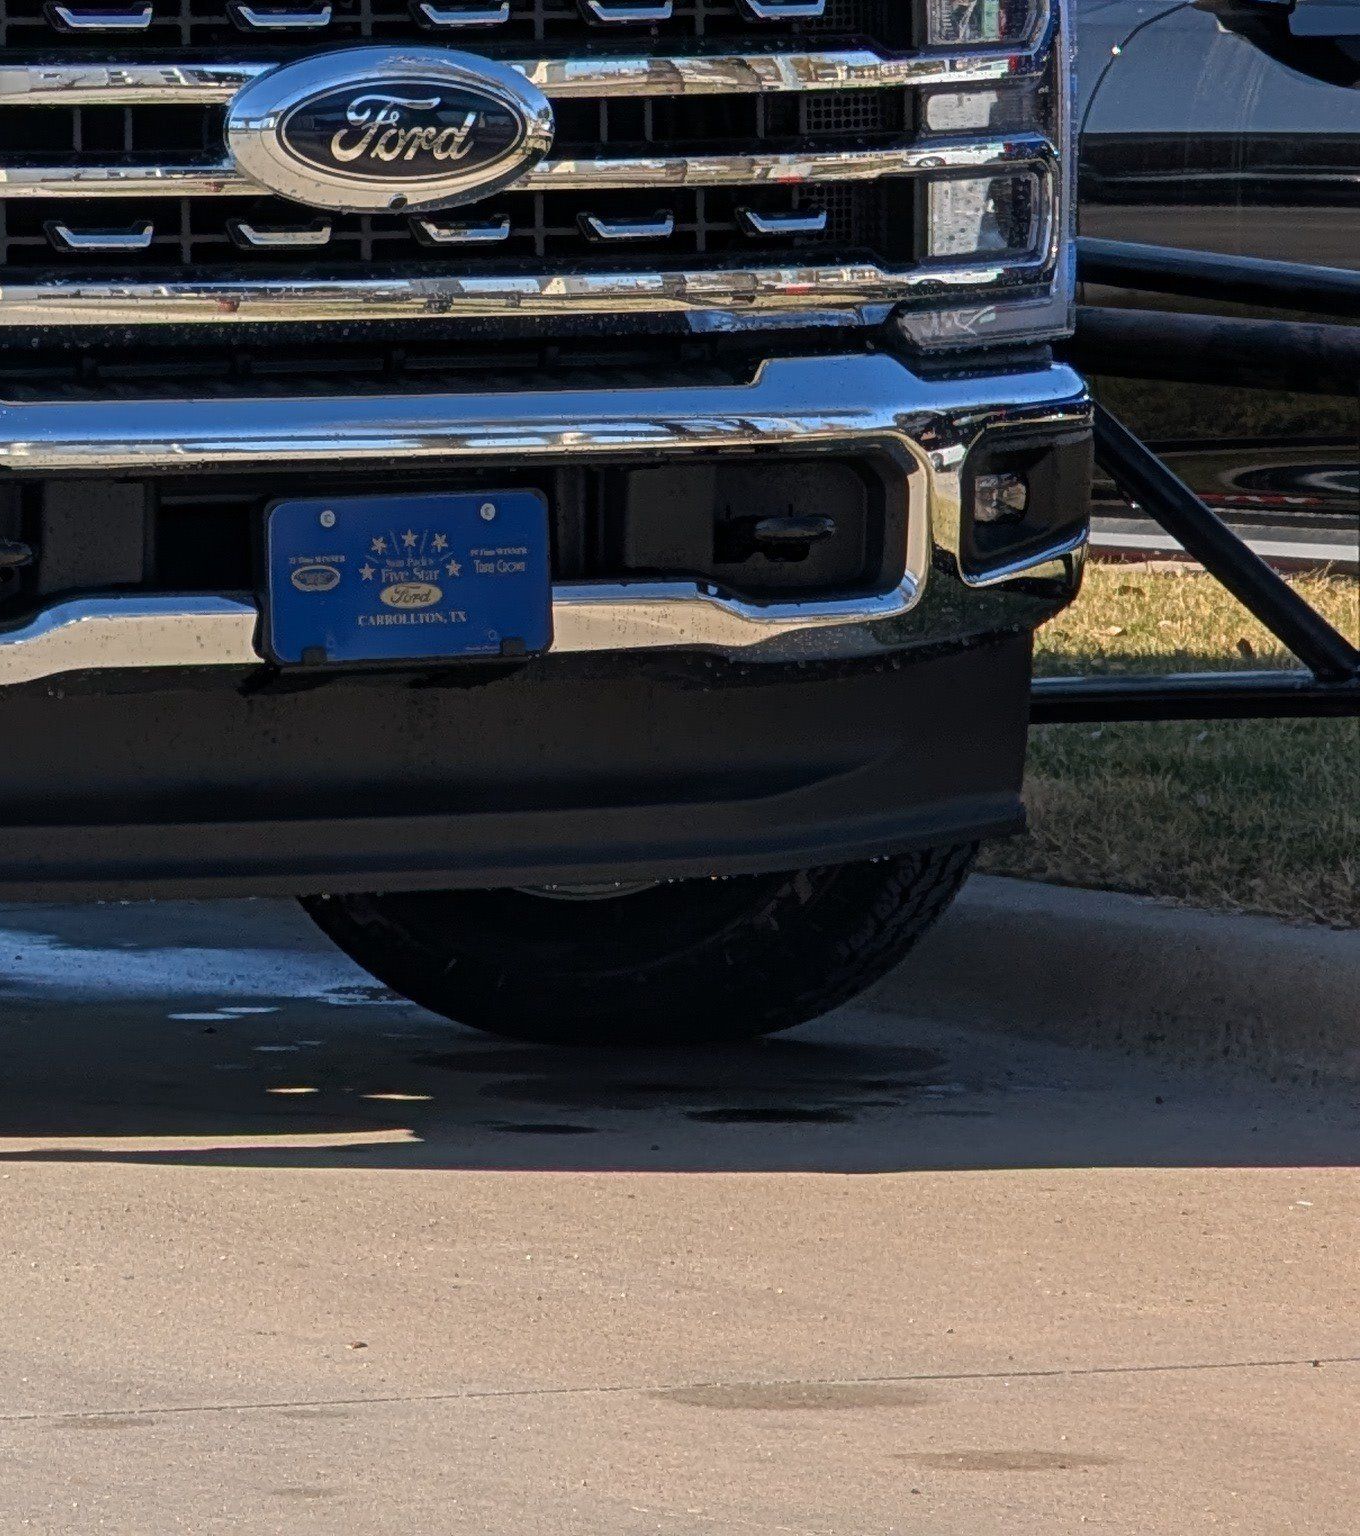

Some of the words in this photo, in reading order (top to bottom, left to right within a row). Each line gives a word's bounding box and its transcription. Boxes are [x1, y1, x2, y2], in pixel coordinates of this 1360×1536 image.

[331, 94, 476, 163] Ford
[390, 585, 432, 604] Ford
[449, 610, 467, 623] TX
